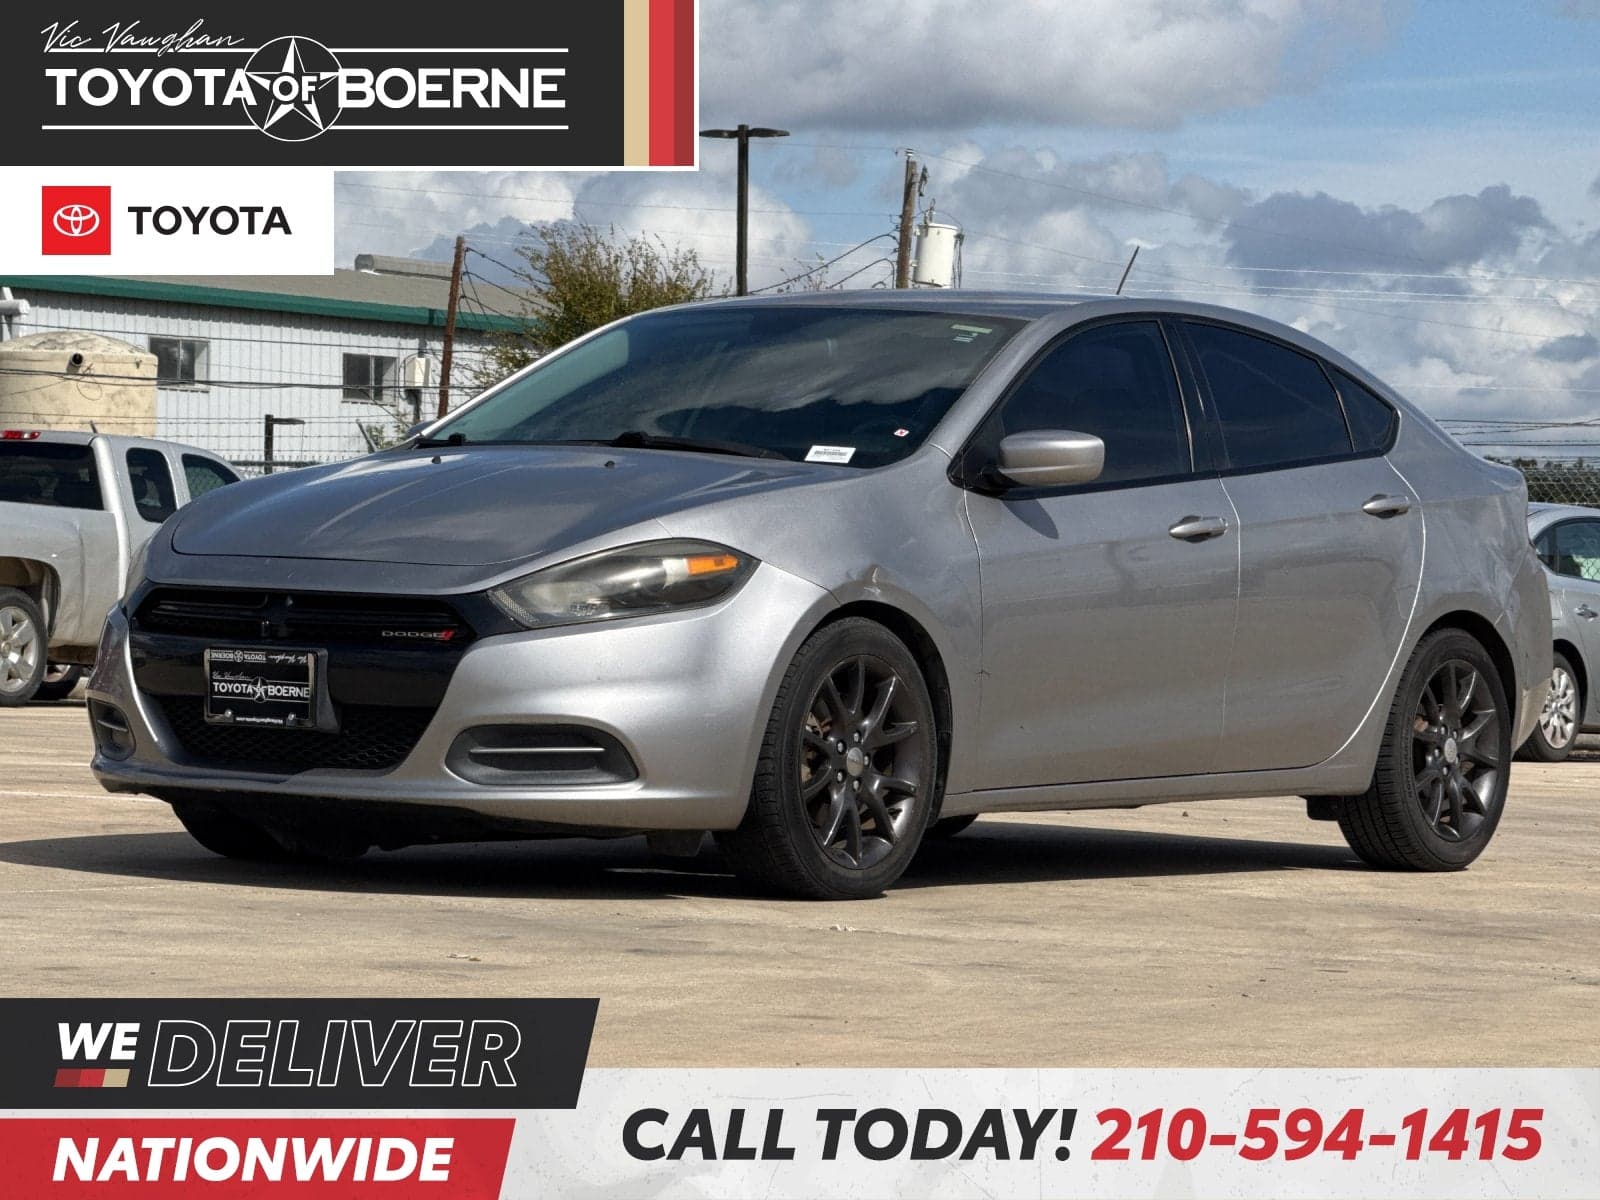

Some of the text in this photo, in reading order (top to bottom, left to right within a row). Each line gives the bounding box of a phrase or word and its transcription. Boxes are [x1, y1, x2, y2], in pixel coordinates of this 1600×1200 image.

[382, 631, 446, 639] DODGE
[212, 682, 253, 693] TOYOTA
[267, 686, 310, 698] BOERNE
